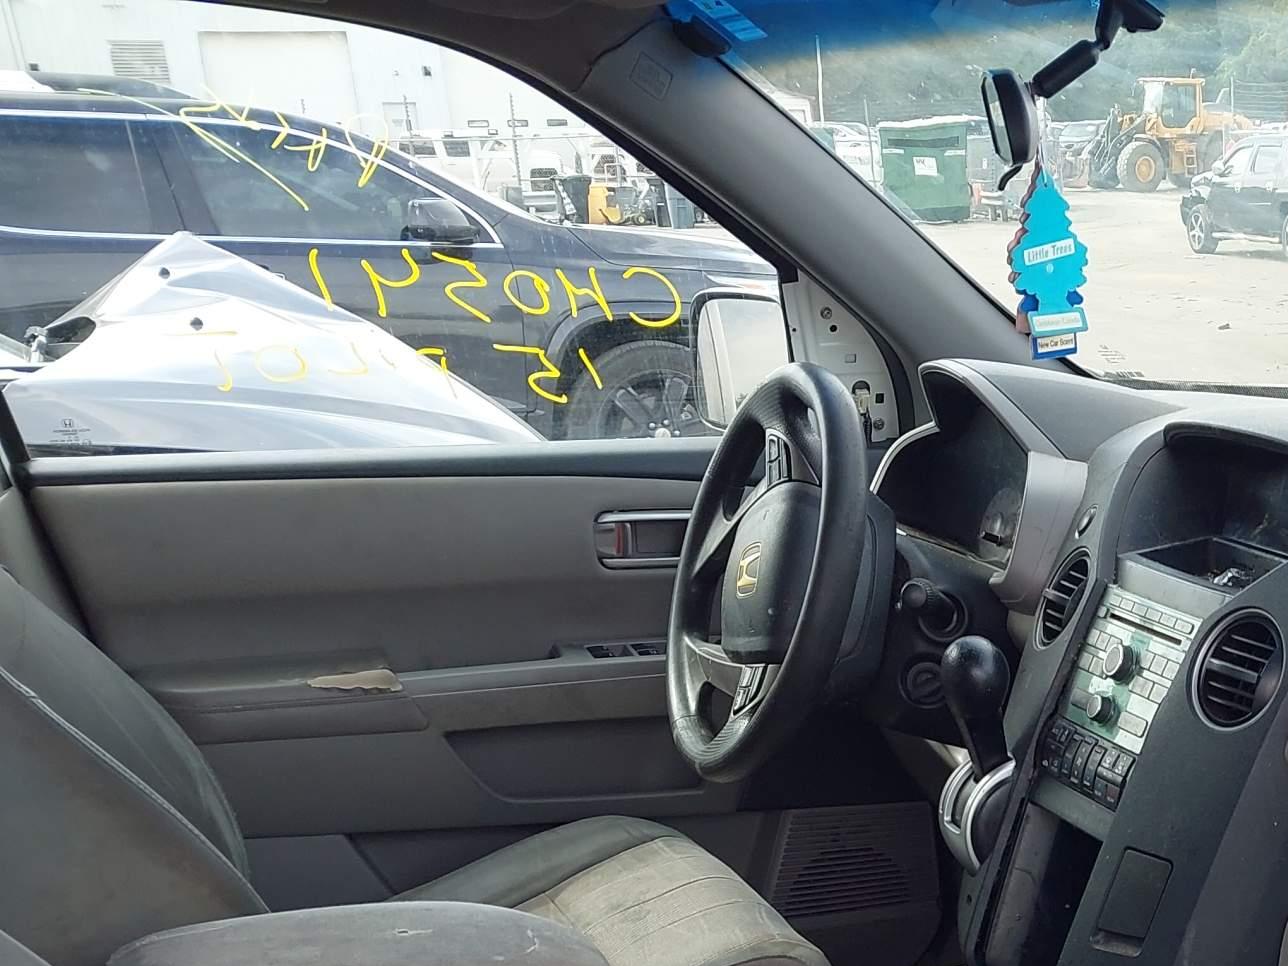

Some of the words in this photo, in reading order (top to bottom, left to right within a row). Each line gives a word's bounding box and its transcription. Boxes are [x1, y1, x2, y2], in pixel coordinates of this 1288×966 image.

[1027, 247, 1049, 263] Little
[1051, 243, 1072, 257] Trees
[1050, 339, 1059, 348] Car
